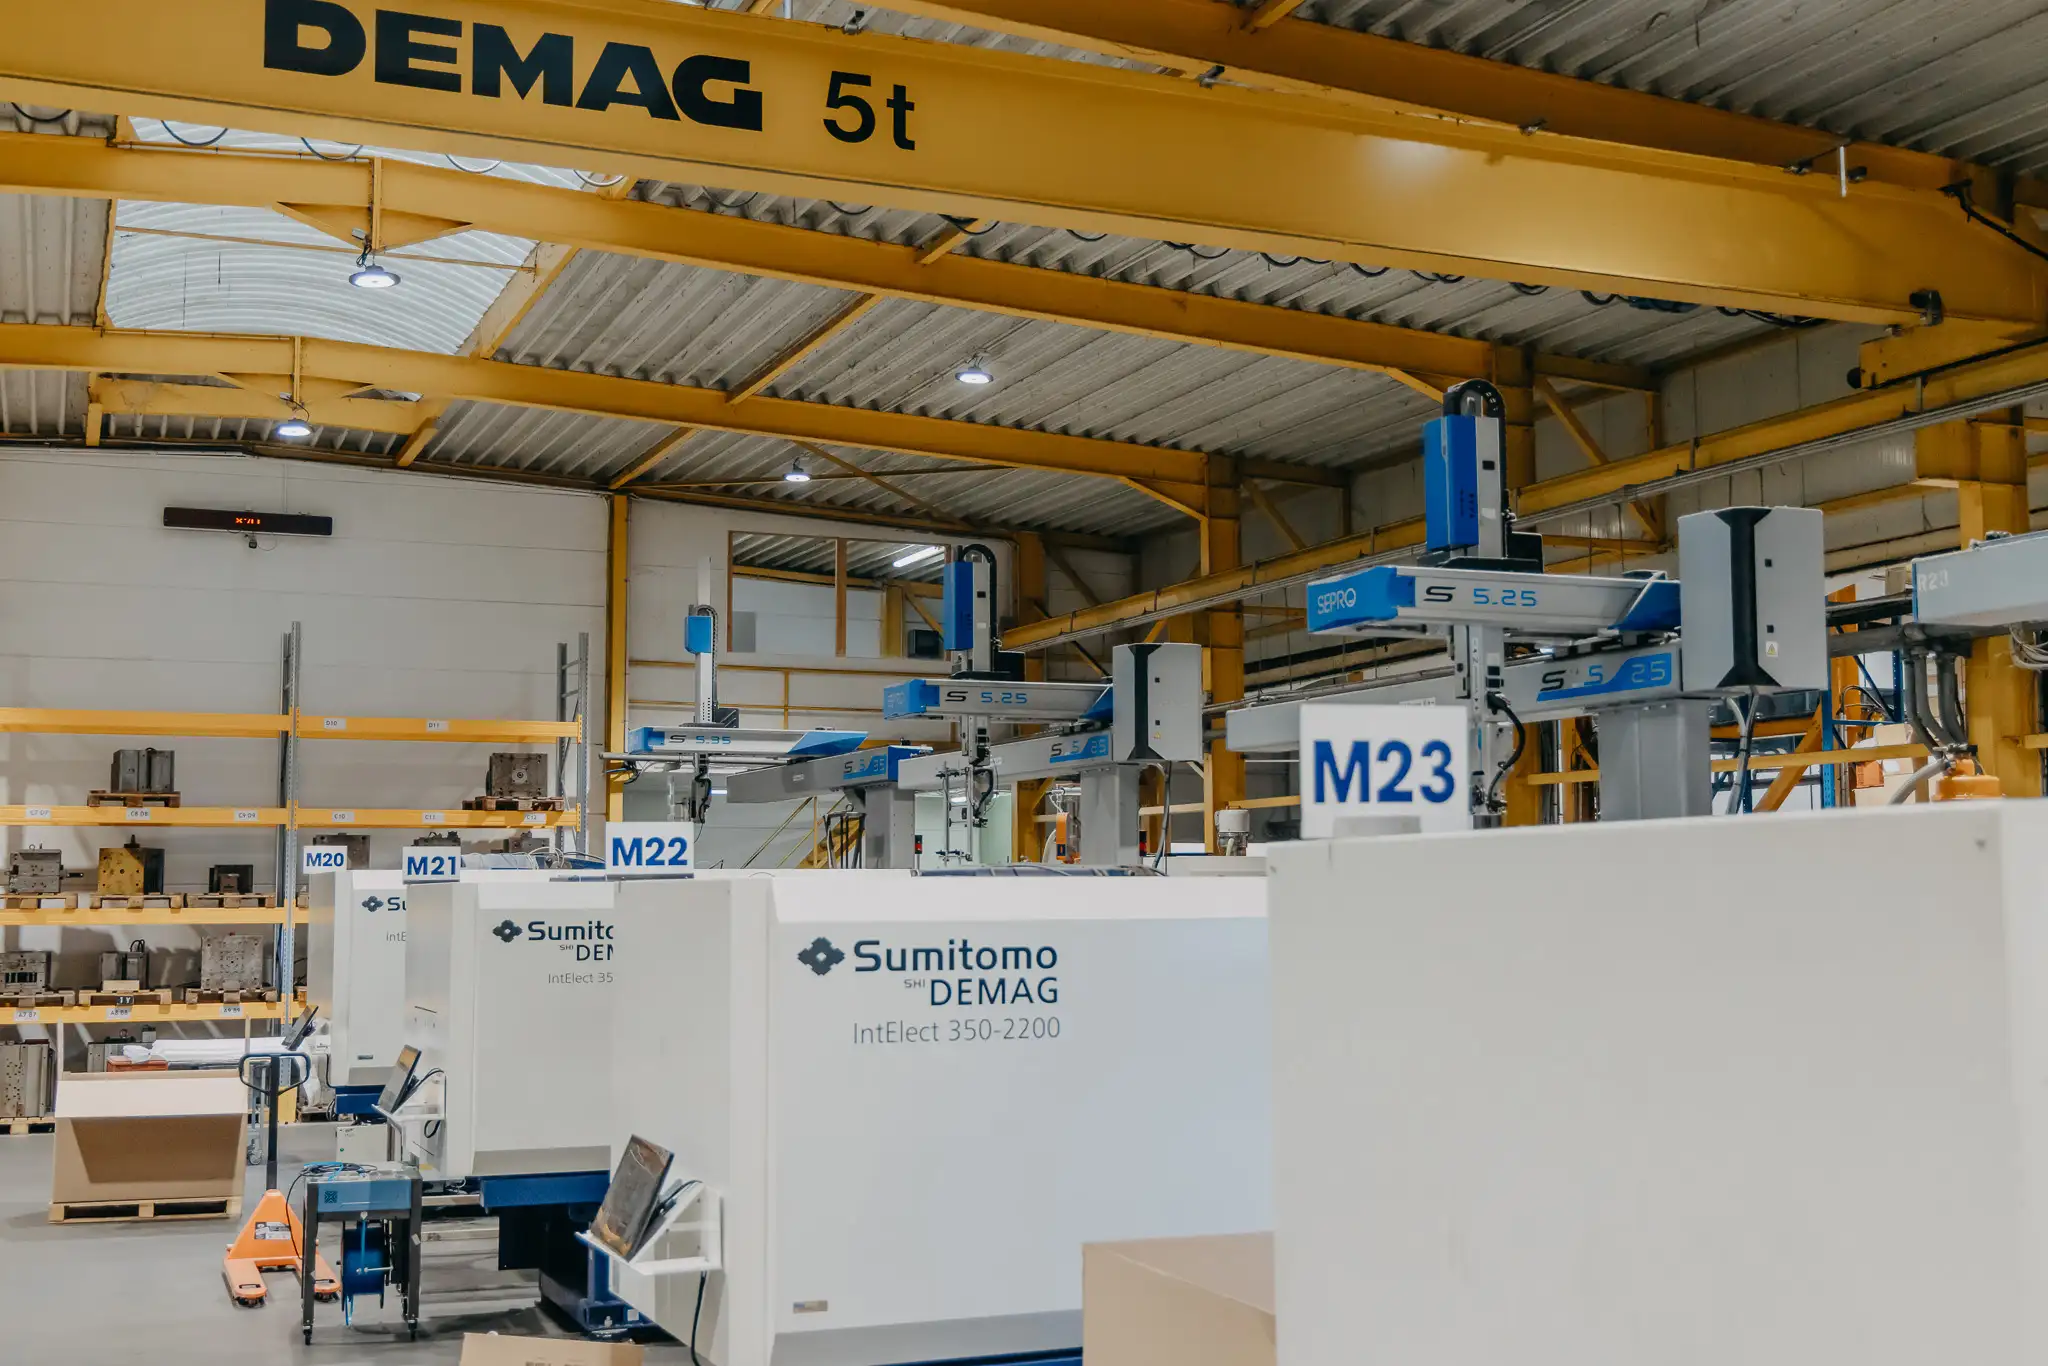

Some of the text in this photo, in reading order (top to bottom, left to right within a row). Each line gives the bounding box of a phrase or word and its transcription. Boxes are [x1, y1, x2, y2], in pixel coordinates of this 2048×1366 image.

[264, 0, 763, 132] DEMAG
[1317, 587, 1357, 615] SEPRO
[1423, 585, 1538, 607] S 5.25
[1540, 669, 1567, 692] S
[980, 691, 1028, 704] 5.25
[695, 735, 732, 745] 5.35
[1313, 738, 1456, 804] M23
[306, 852, 345, 867] M20
[611, 836, 689, 867] M22
[406, 855, 457, 876] M21
[853, 938, 1058, 972] Sumitomo
[548, 972, 594, 984] IntElect
[904, 976, 1059, 1006] SHI DEMAG
[853, 1016, 1061, 1044] IntElect 350-2200
